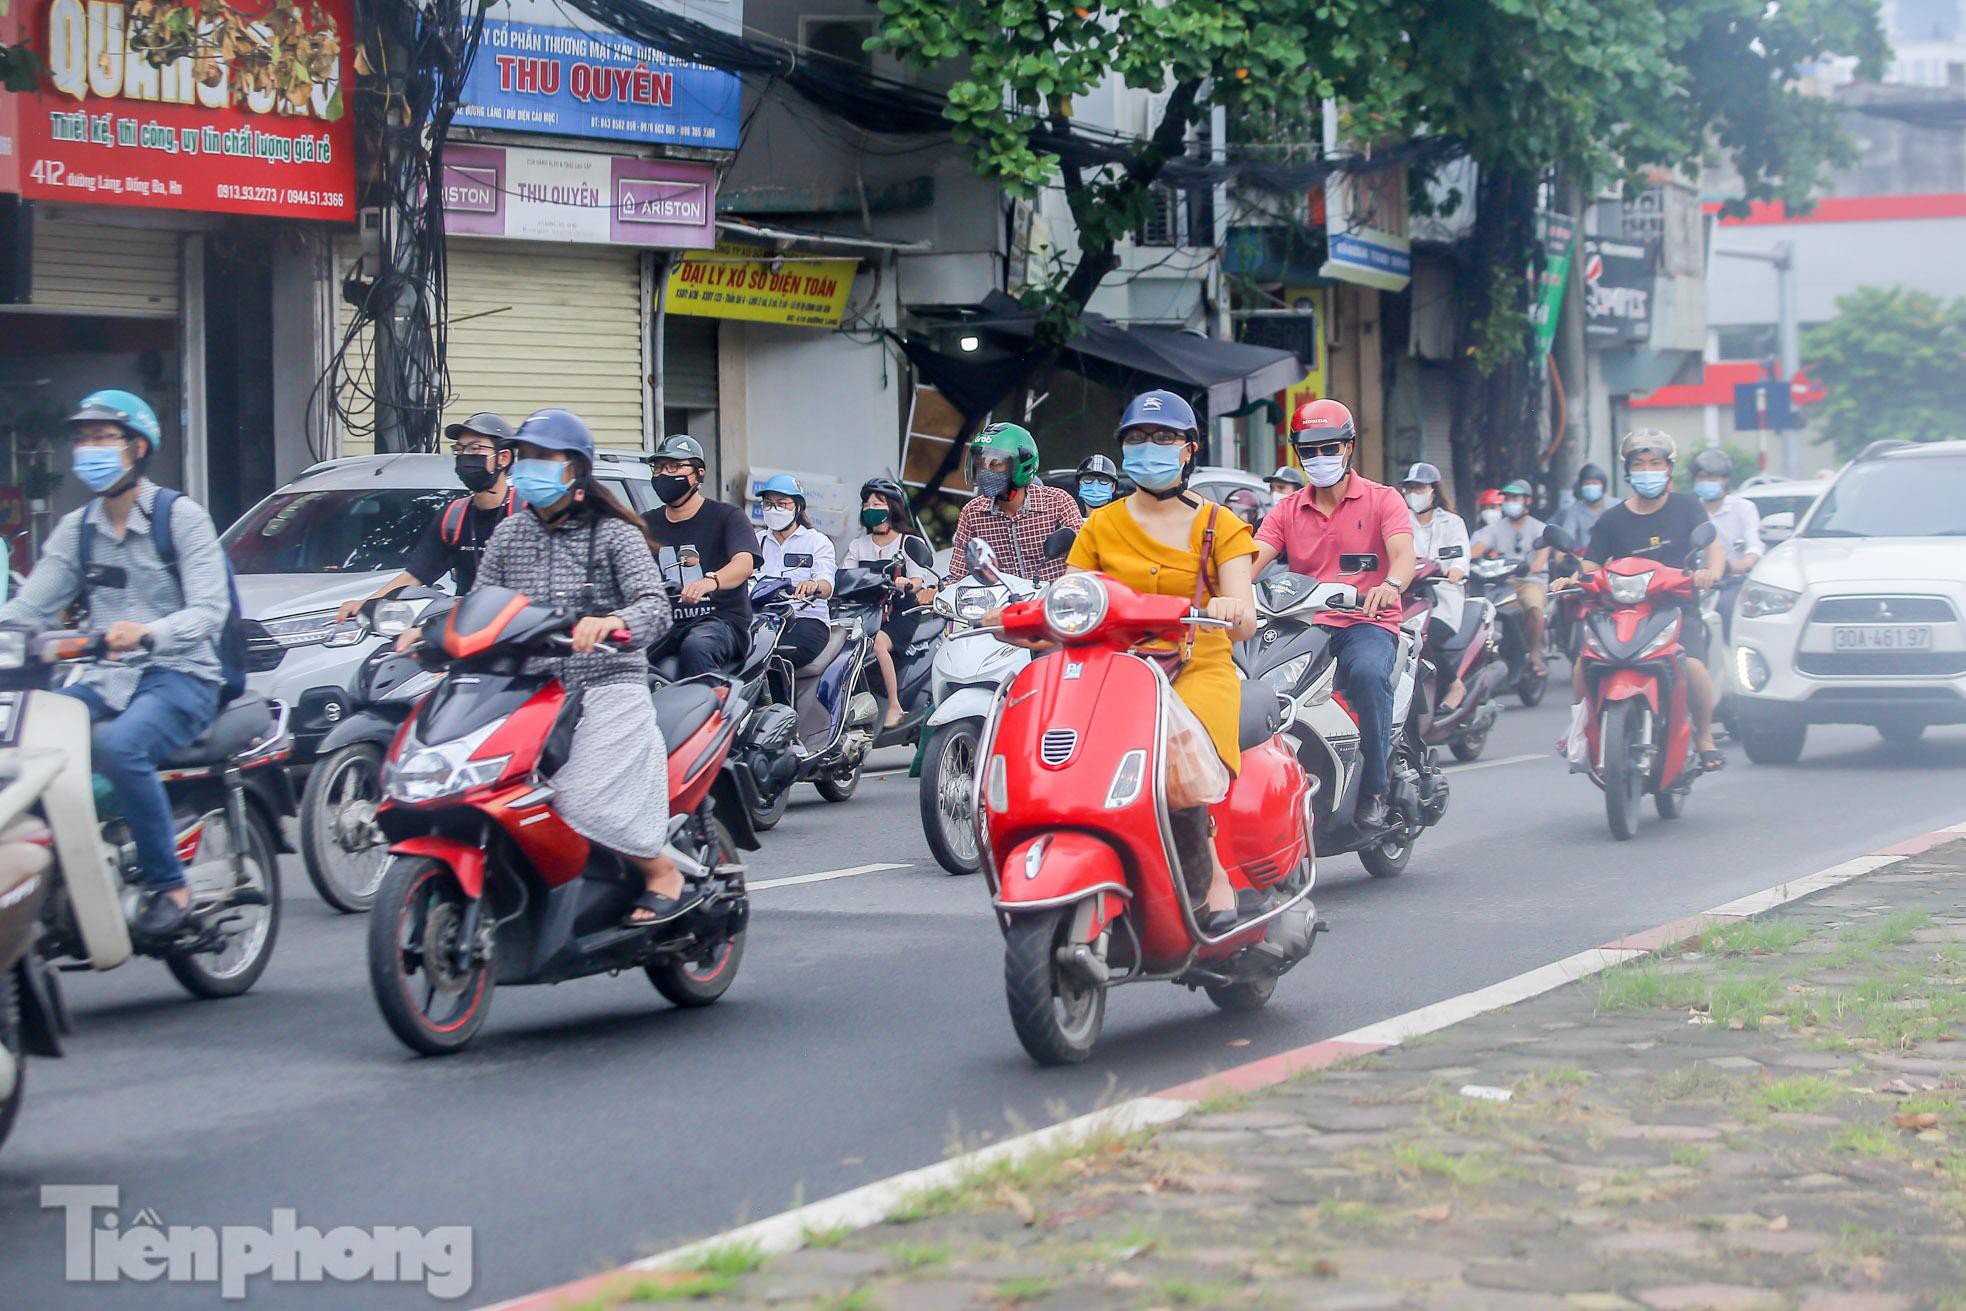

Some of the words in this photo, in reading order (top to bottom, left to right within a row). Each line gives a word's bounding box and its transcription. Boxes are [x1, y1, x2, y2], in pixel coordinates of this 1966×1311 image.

[496, 54, 560, 95] THU
[570, 63, 673, 107] QUYÊN
[181, 128, 199, 155] uy
[222, 124, 253, 157] chất
[254, 130, 291, 164] lượng
[293, 134, 315, 163] giá
[316, 134, 332, 163] rẻ
[29, 159, 65, 186] 412
[518, 183, 547, 203] THU
[641, 198, 700, 218] ARISTON
